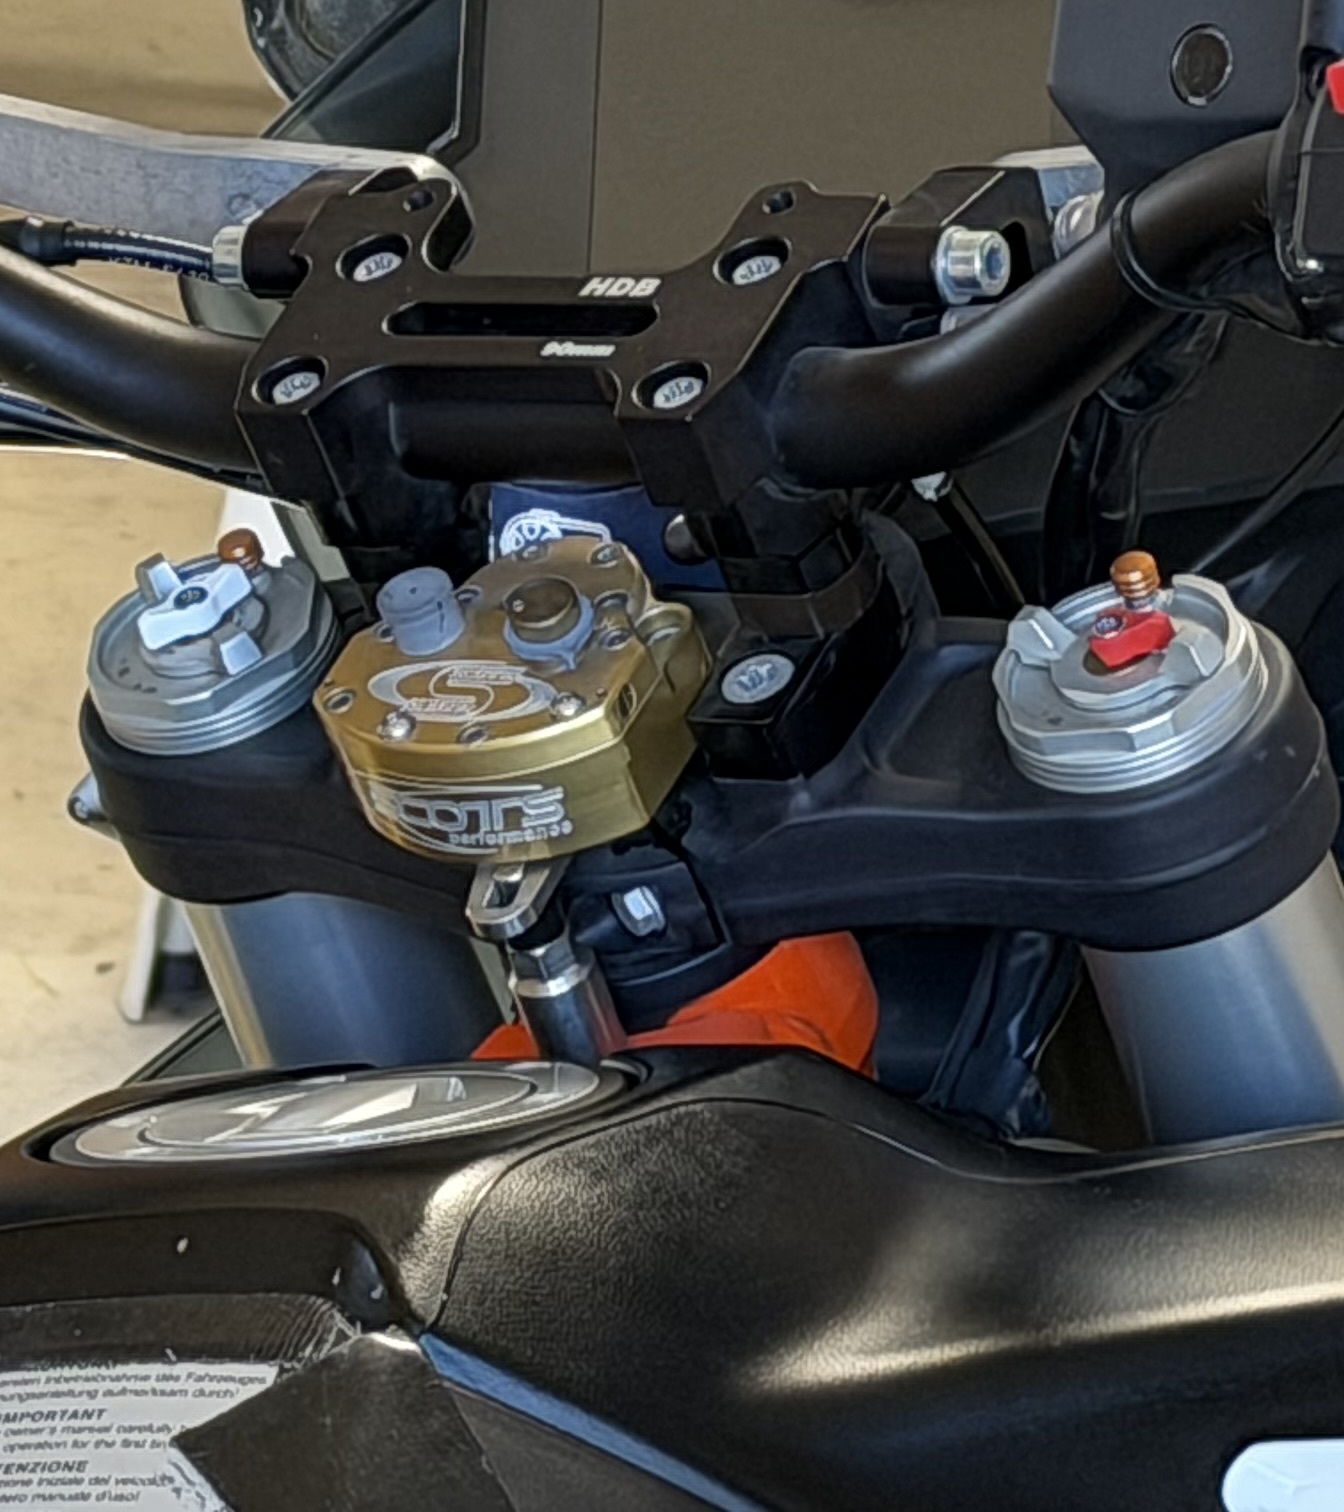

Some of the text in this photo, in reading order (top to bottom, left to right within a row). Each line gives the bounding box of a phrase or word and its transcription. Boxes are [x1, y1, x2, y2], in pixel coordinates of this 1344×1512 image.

[578, 276, 662, 298] HDB
[449, 820, 573, 846] performance
[71, 1438, 91, 1449] for
[93, 1437, 116, 1450] the
